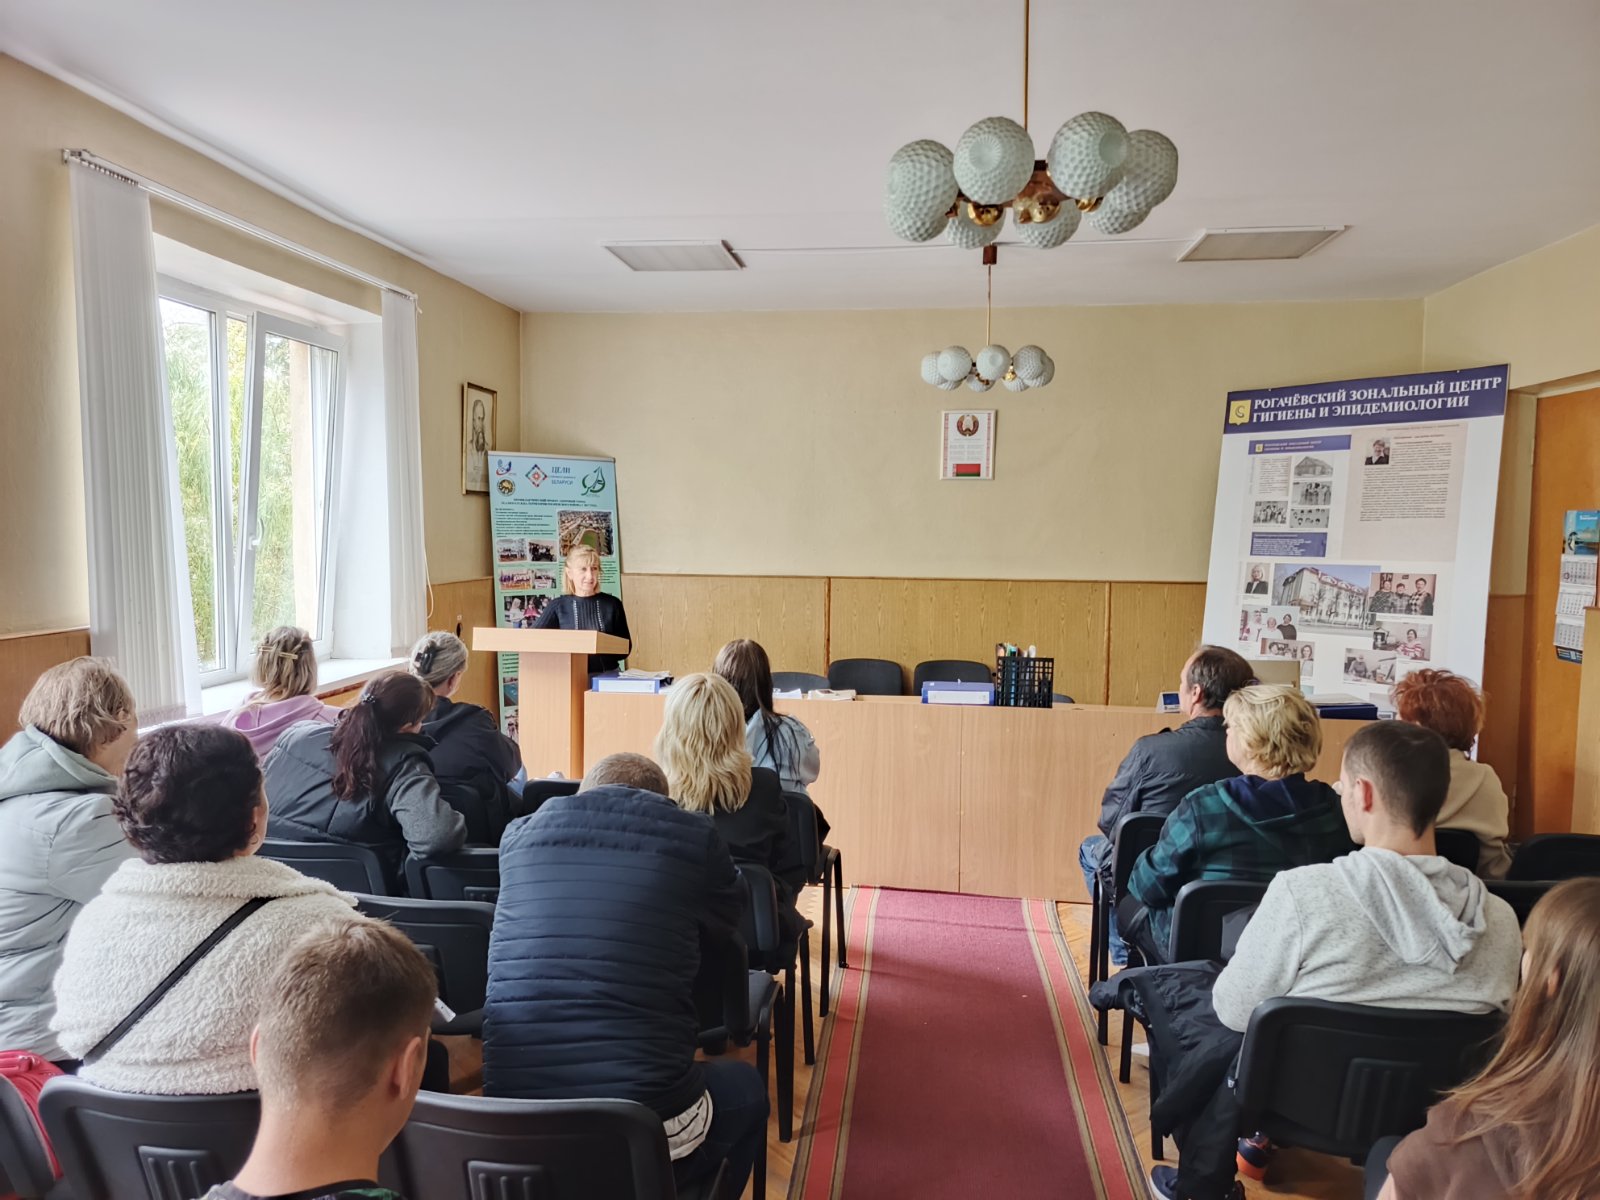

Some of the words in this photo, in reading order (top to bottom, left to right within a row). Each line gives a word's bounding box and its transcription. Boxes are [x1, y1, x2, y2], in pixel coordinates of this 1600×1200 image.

[1254, 389, 1347, 409] РОГАЧЁВСКИЙ
[1349, 380, 1445, 400] ЗОНАЛЬНЫЙ
[1449, 377, 1502, 394] ЦЕНТР
[1253, 408, 1315, 423] ГИГИЕНЫ
[1319, 406, 1329, 418] И
[1332, 395, 1470, 417] ЭПИДЕМИОЛОГИИ
